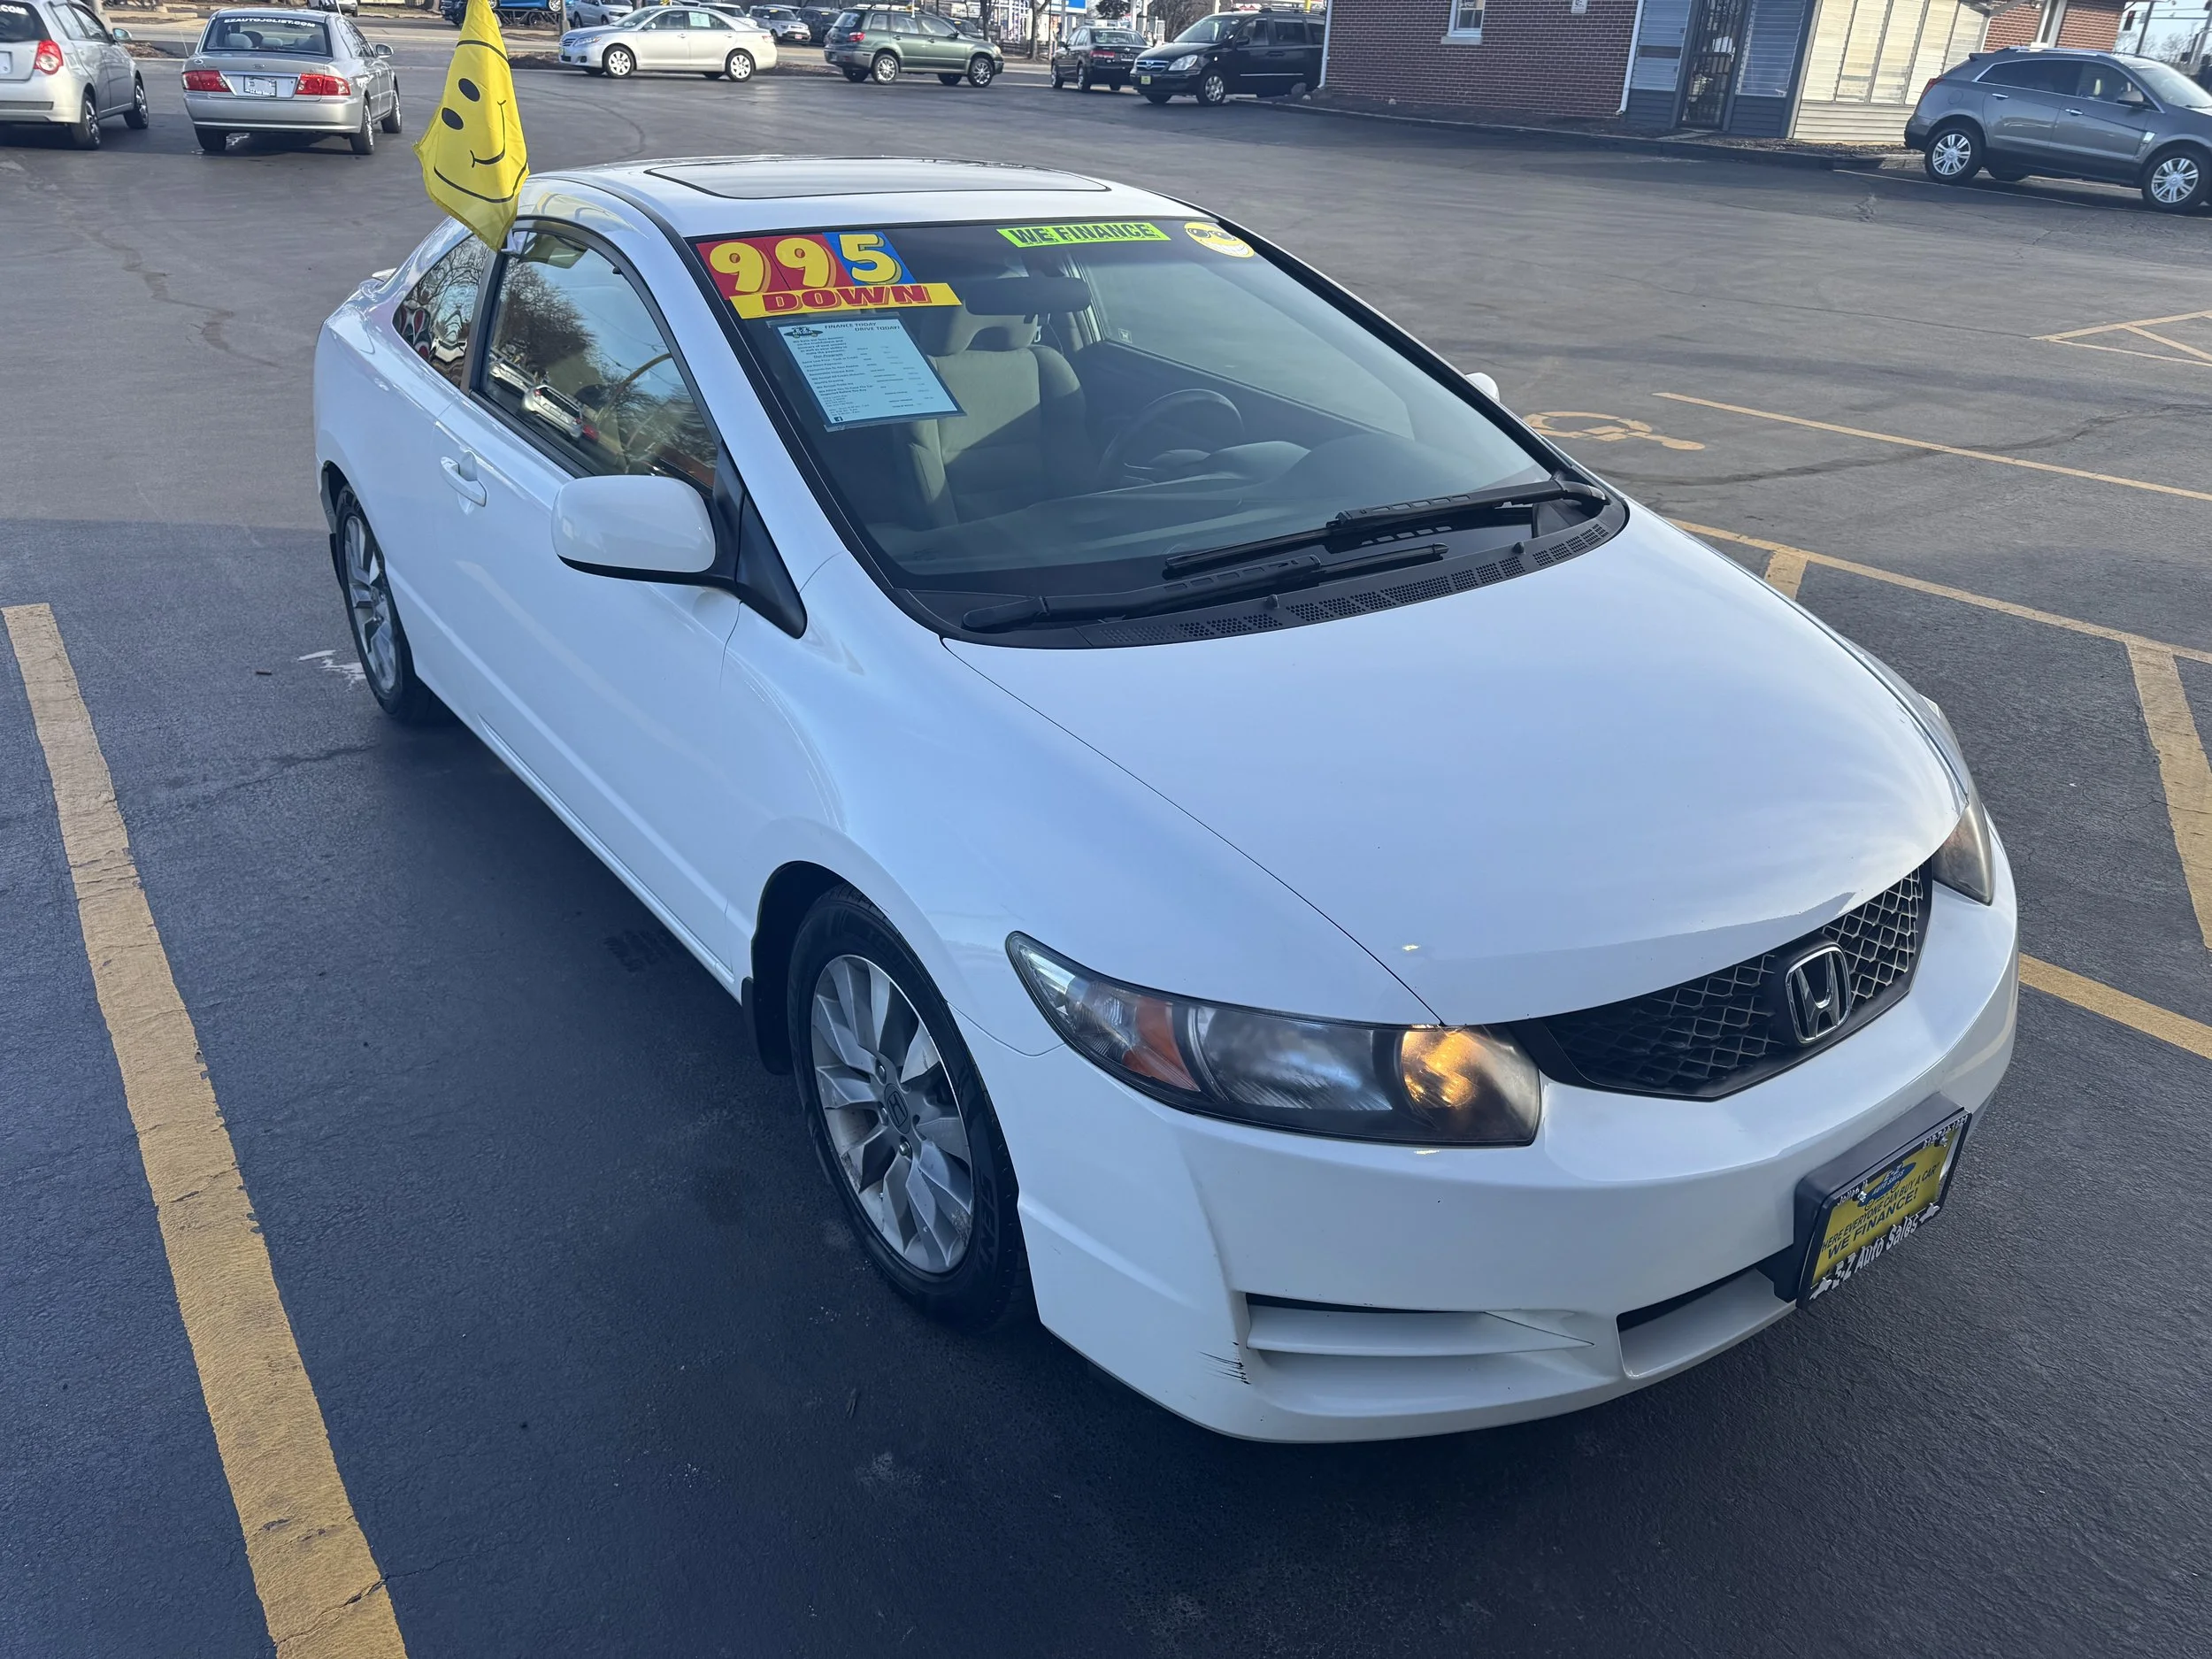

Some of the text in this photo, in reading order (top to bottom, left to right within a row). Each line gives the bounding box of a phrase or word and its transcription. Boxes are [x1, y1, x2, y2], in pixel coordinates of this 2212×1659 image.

[1009, 223, 1157, 245] WE FINANCE
[709, 234, 903, 294] 995
[762, 285, 933, 312] DOWN
[1828, 1187, 1918, 1259] WE FINANCE!
[1843, 1200, 1885, 1237] EVERYONE
[1884, 1188, 1900, 1209] CAN
[1899, 1179, 1915, 1197] BUY
[1855, 1236, 1885, 1274] Auto
[1886, 1213, 1920, 1251] Sales
